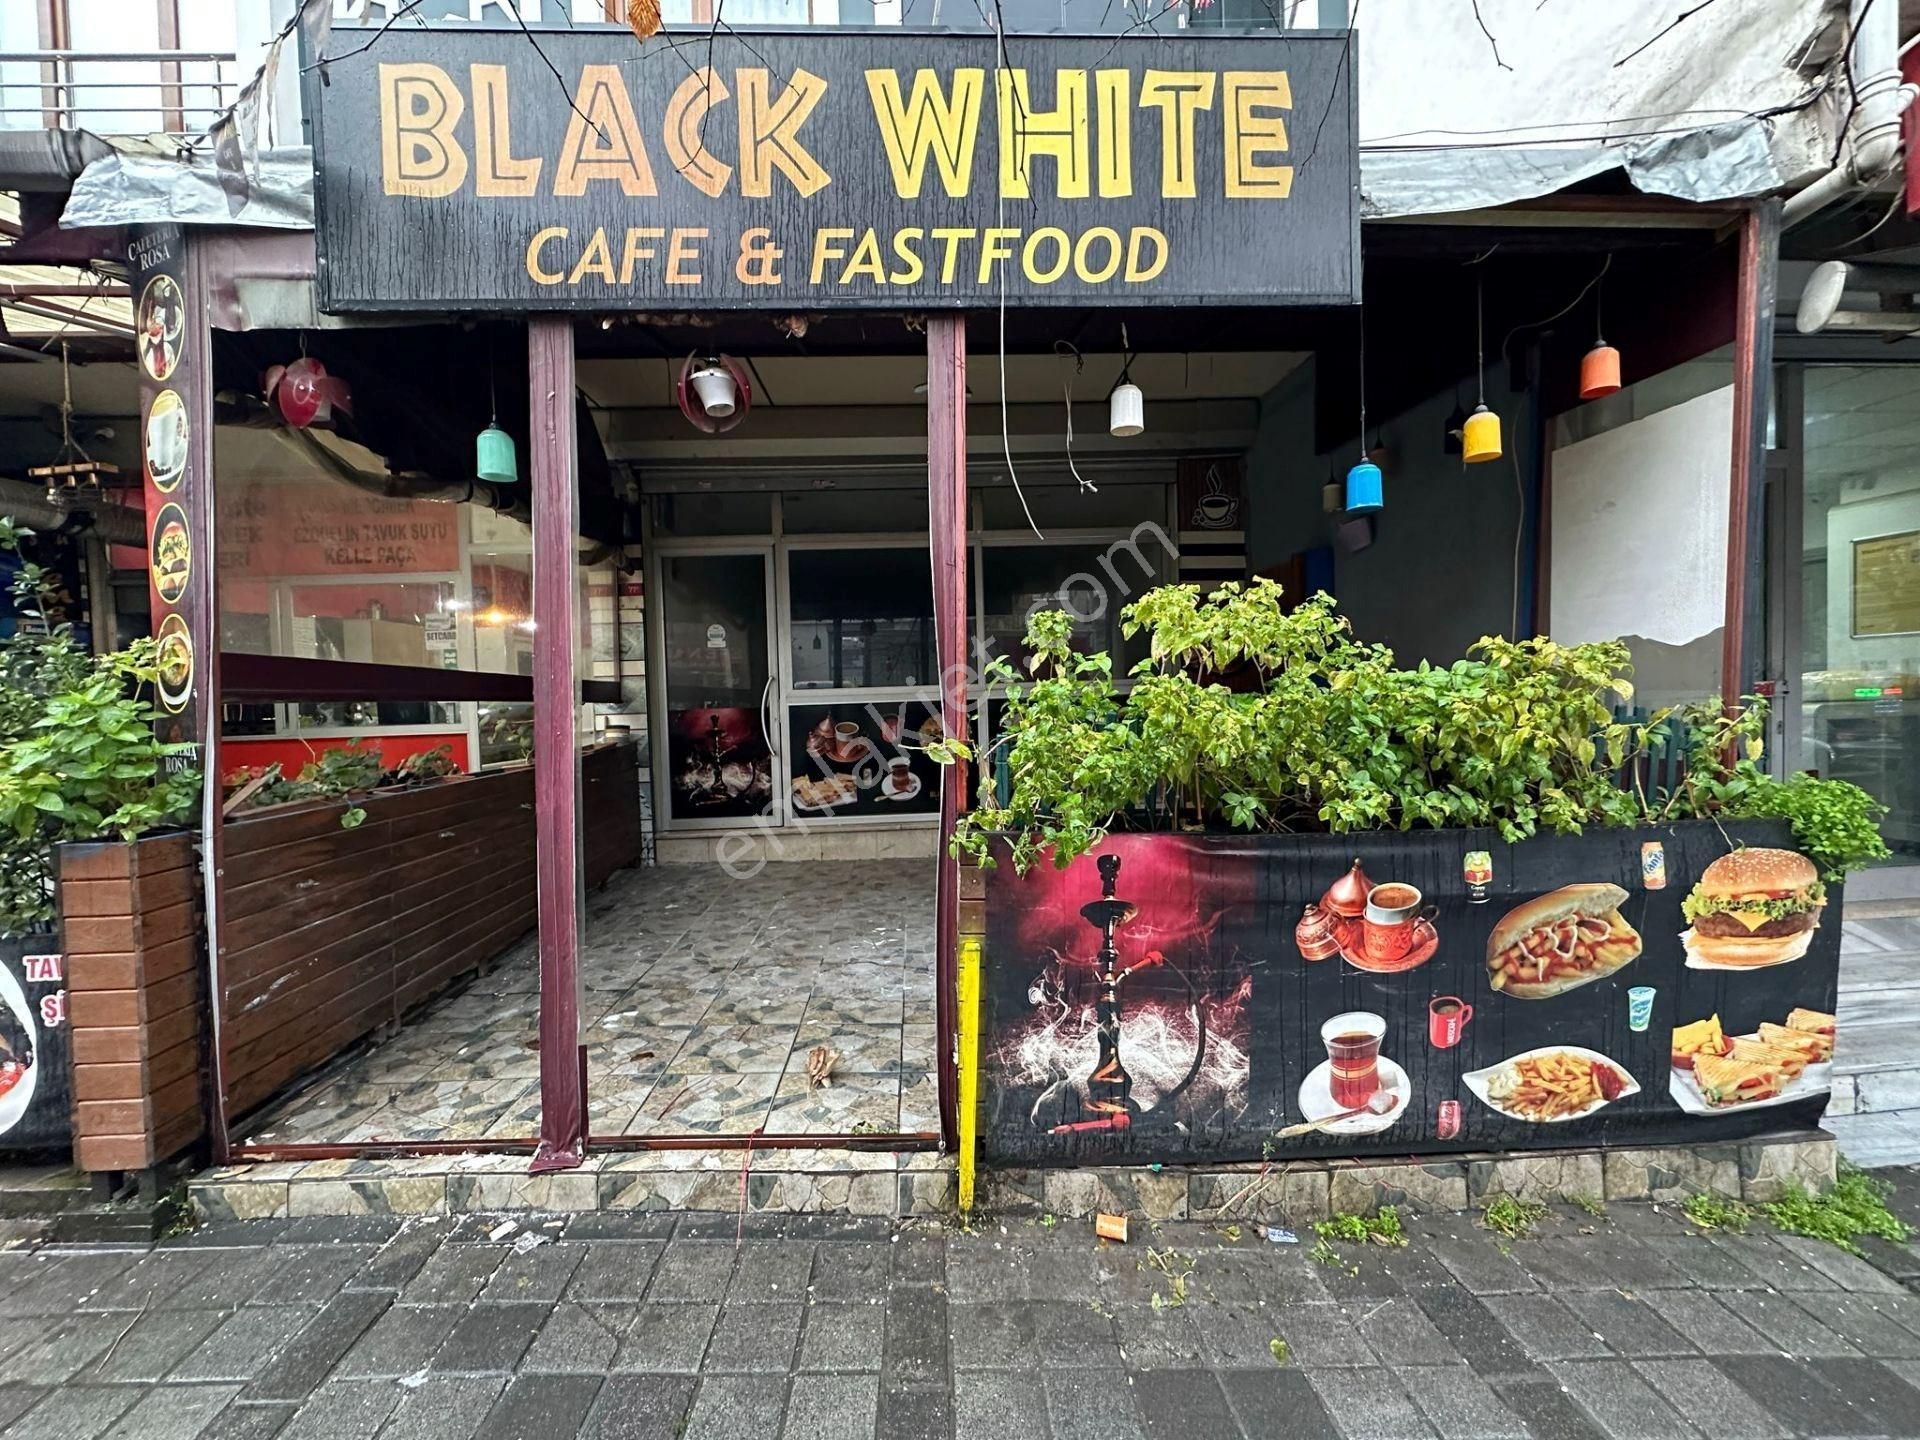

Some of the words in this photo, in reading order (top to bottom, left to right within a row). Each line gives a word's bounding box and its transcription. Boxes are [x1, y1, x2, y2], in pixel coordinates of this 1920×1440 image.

[379, 63, 832, 198] BLACK
[864, 68, 1293, 198] WHITE
[140, 243, 170, 271] ROSA
[526, 227, 708, 284] CAFE
[735, 227, 782, 285] &
[809, 227, 1169, 285] FASTFOOD
[411, 522, 448, 540] SUYU
[325, 548, 373, 566] KELLE
